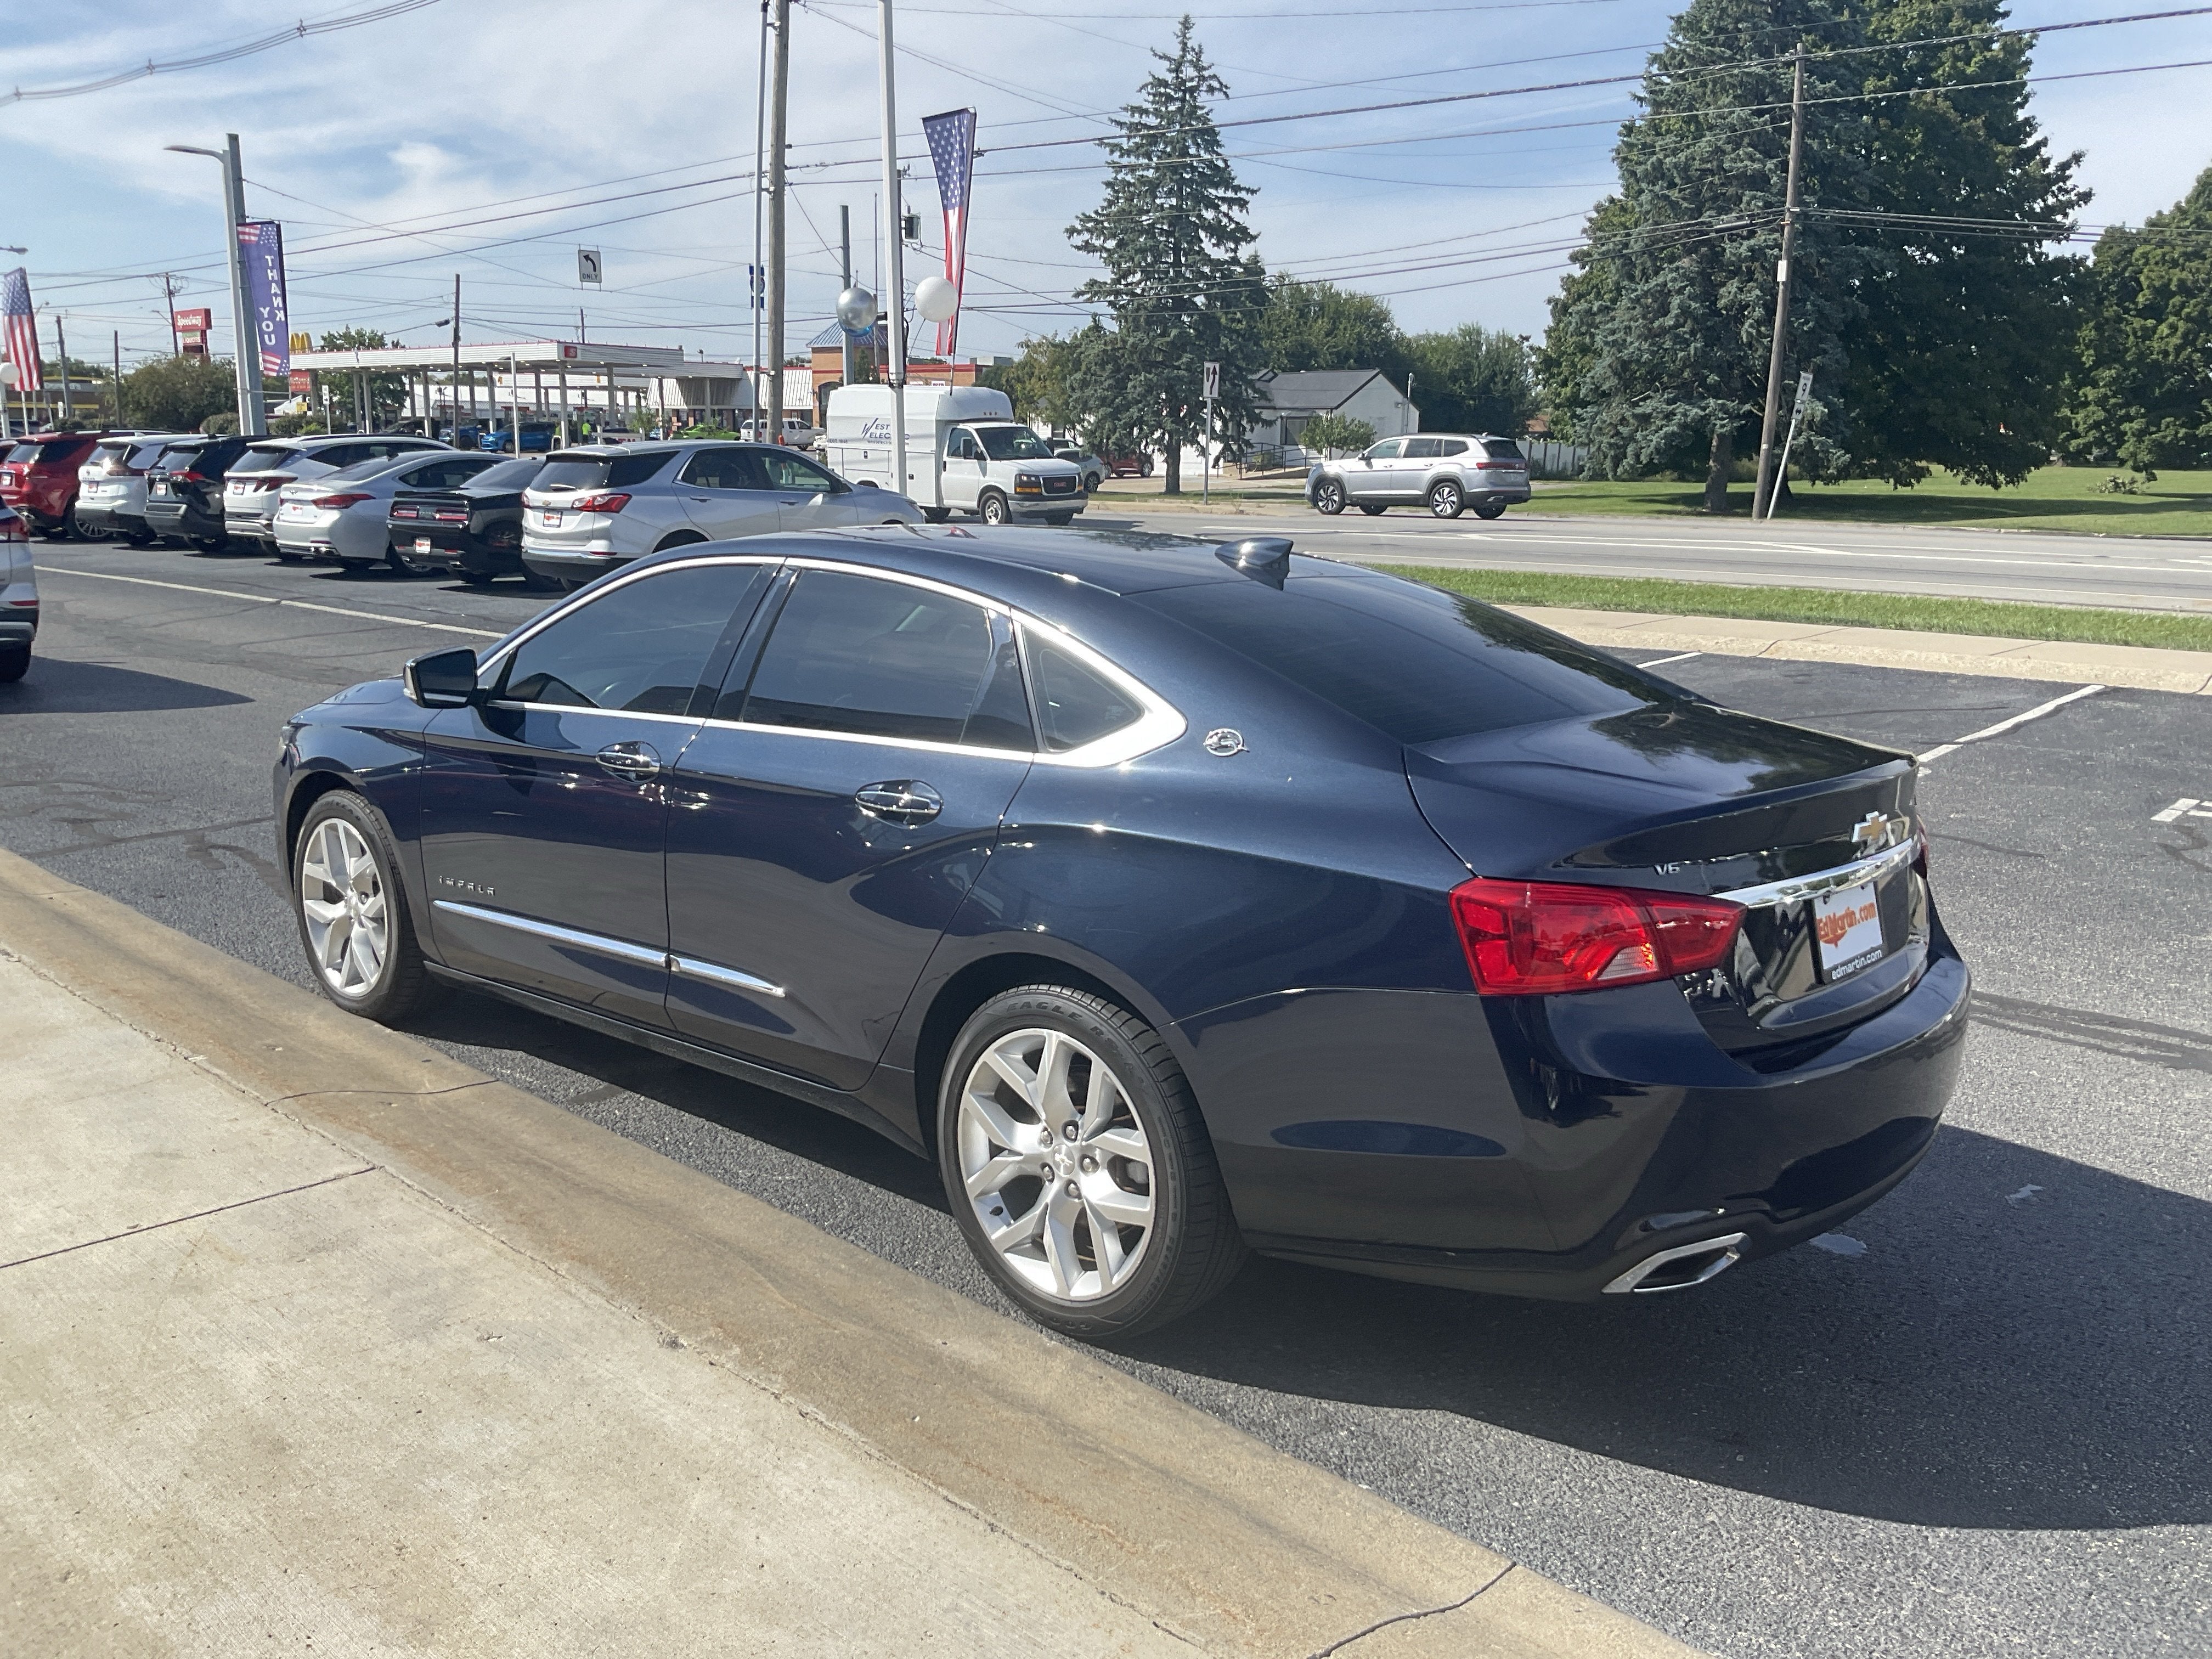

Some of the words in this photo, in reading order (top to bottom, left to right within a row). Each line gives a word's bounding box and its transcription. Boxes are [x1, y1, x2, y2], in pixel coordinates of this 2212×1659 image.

[177, 315, 202, 329] Speedway
[861, 417, 890, 439] WEST
[869, 432, 911, 440] ELECC
[1654, 862, 1680, 875] V6
[439, 876, 494, 896] IMPALA
[1831, 949, 1883, 980] edmartin.com
[1006, 1001, 1083, 1021] EAGLE
